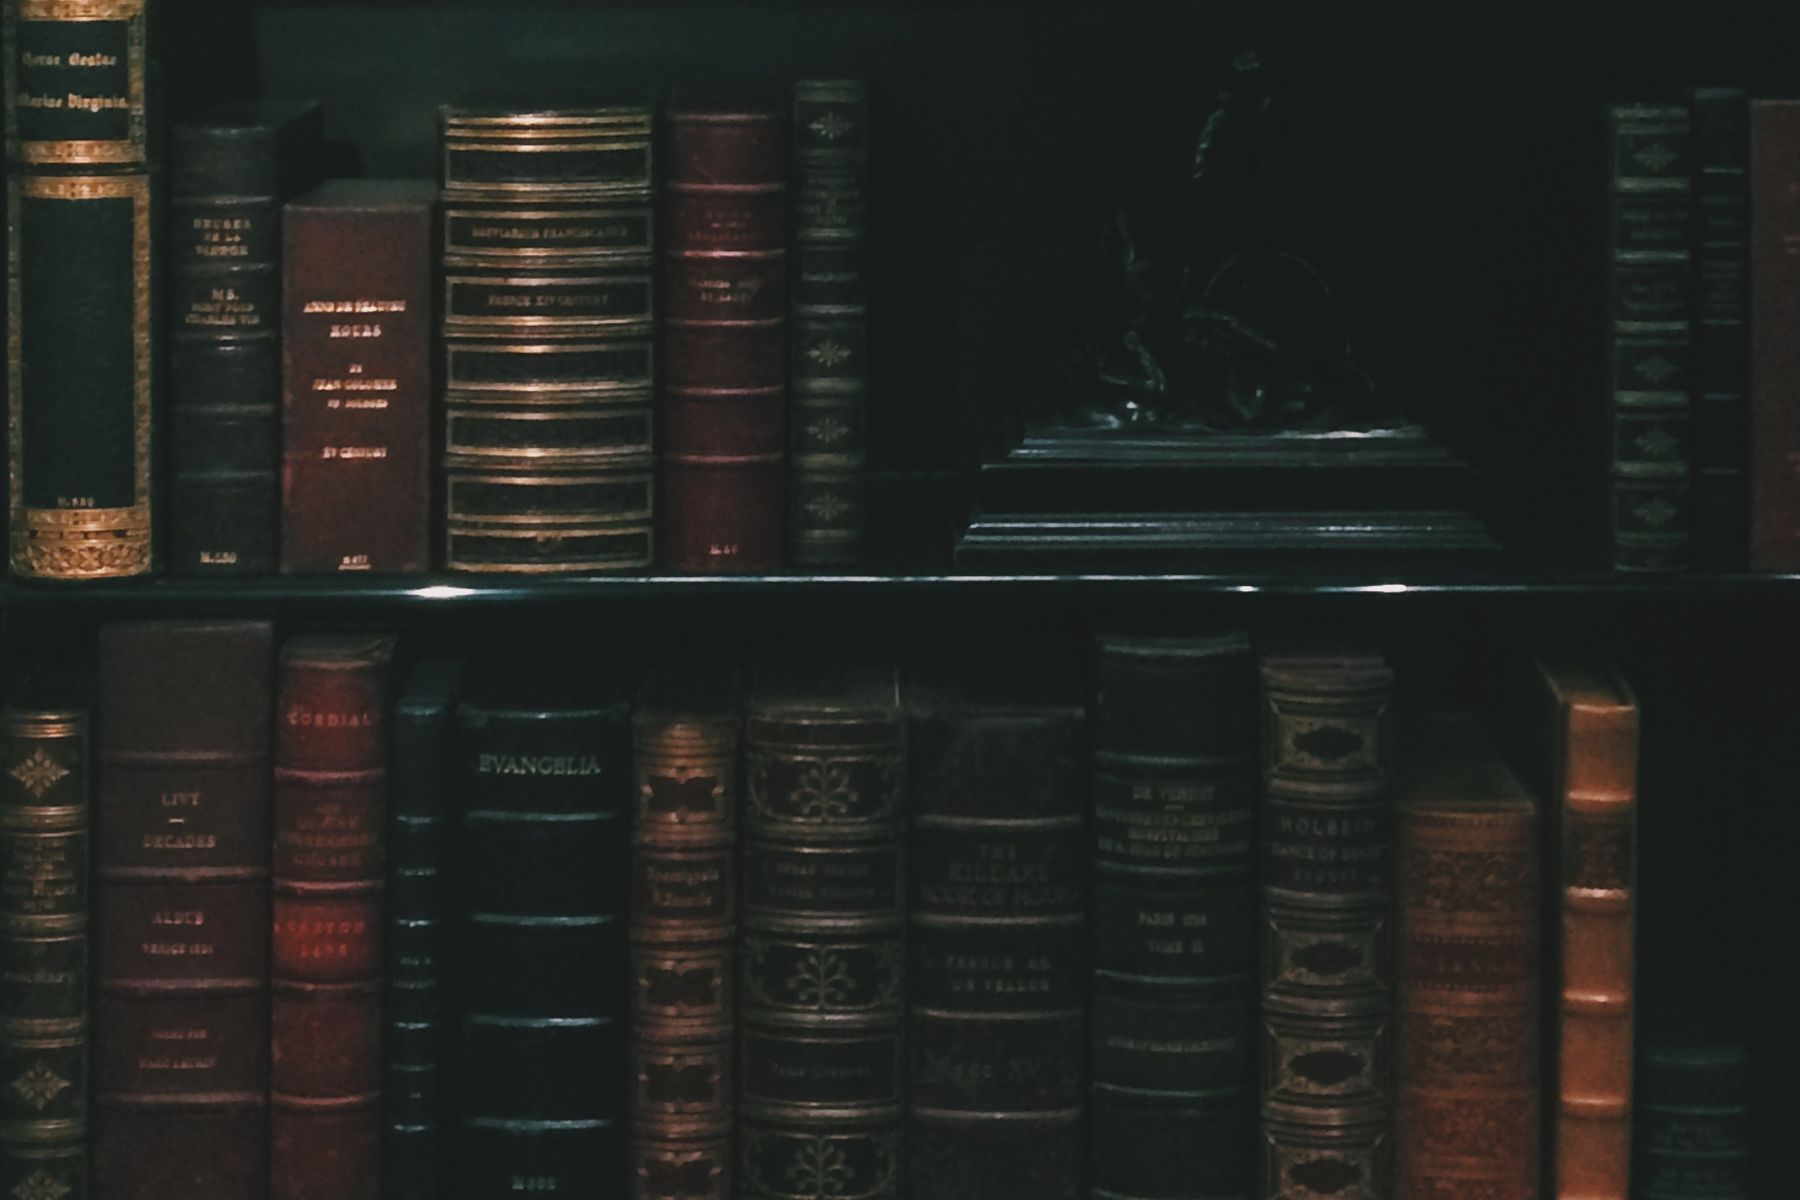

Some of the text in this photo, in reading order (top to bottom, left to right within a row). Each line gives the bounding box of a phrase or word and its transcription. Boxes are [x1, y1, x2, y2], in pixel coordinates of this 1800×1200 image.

[288, 711, 372, 728] CORDIAL
[479, 753, 602, 776] EVANGELIA
[161, 791, 201, 806] LIVY
[1280, 815, 1376, 836] HOLBEIN
[142, 833, 217, 849] DECADES
